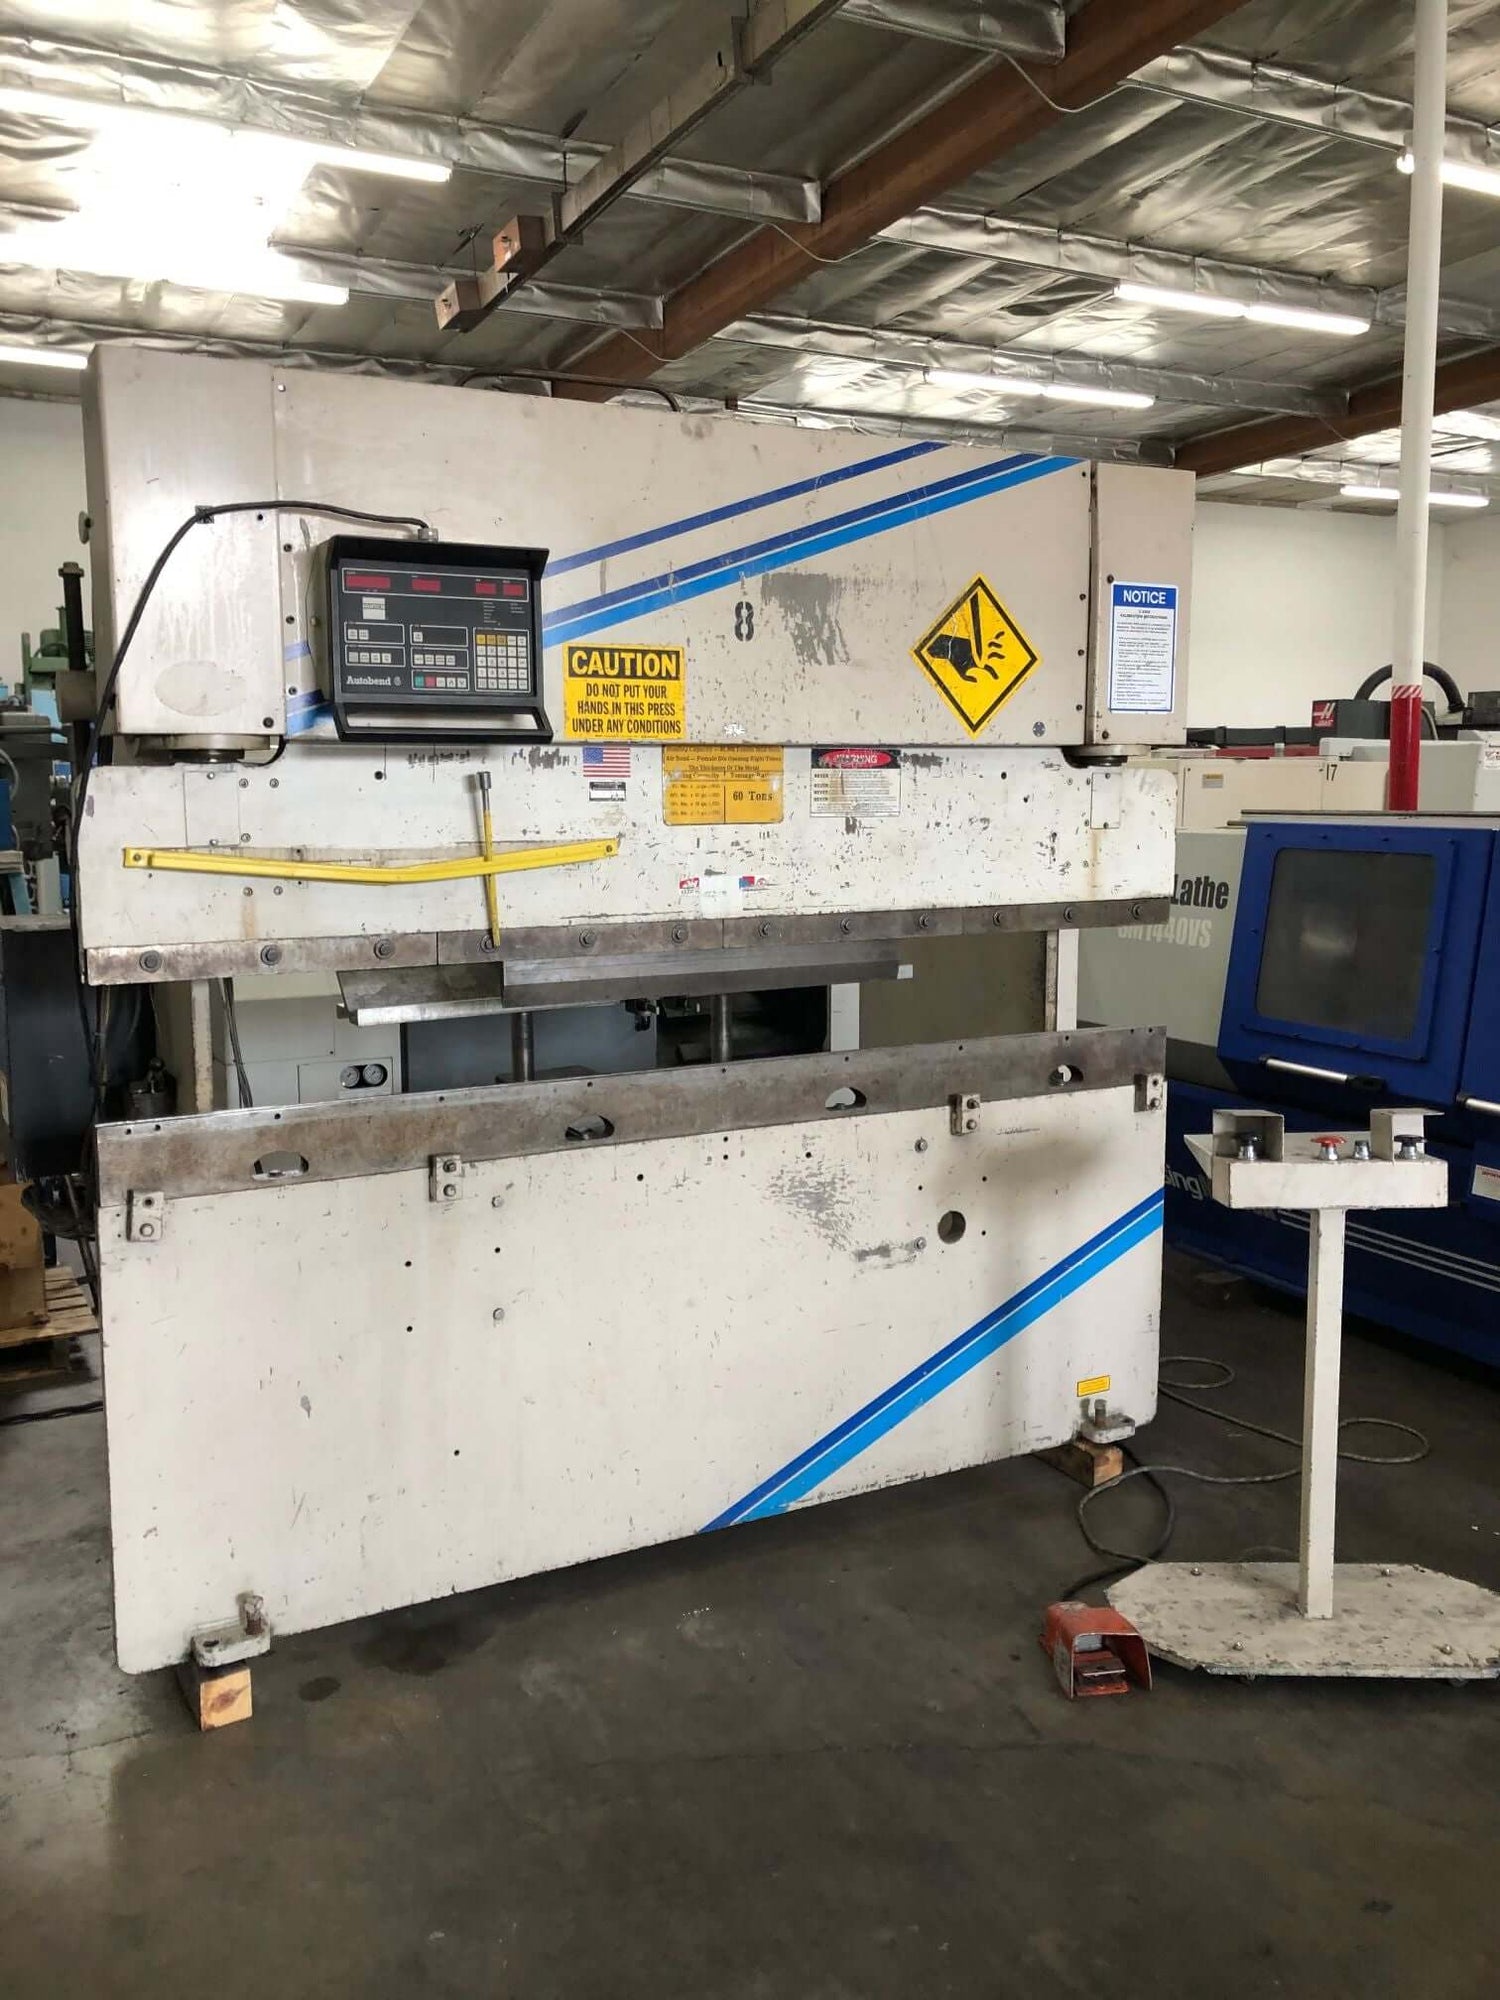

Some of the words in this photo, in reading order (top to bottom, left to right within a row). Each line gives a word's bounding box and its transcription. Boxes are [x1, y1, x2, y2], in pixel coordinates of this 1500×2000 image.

[1123, 589, 1167, 605] NOTICE
[735, 601, 754, 642] 8
[571, 650, 677, 677] CAUTION
[346, 675, 391, 686] Autobend
[586, 683, 599, 697] DO
[602, 683, 620, 698] NOT
[623, 684, 640, 698] PUT
[643, 685, 667, 699] YOUR
[577, 700, 609, 715] HANDS
[612, 701, 621, 715] IN
[624, 702, 645, 716] THIS
[648, 702, 675, 716] PRESS
[572, 718, 604, 733] UNDER
[606, 719, 624, 733] ANY
[627, 720, 682, 734] CONDITIONS
[1326, 763, 1338, 781] 17
[733, 791, 743, 801] 60
[749, 791, 773, 801] Tons
[1171, 874, 1229, 909] Lathe
